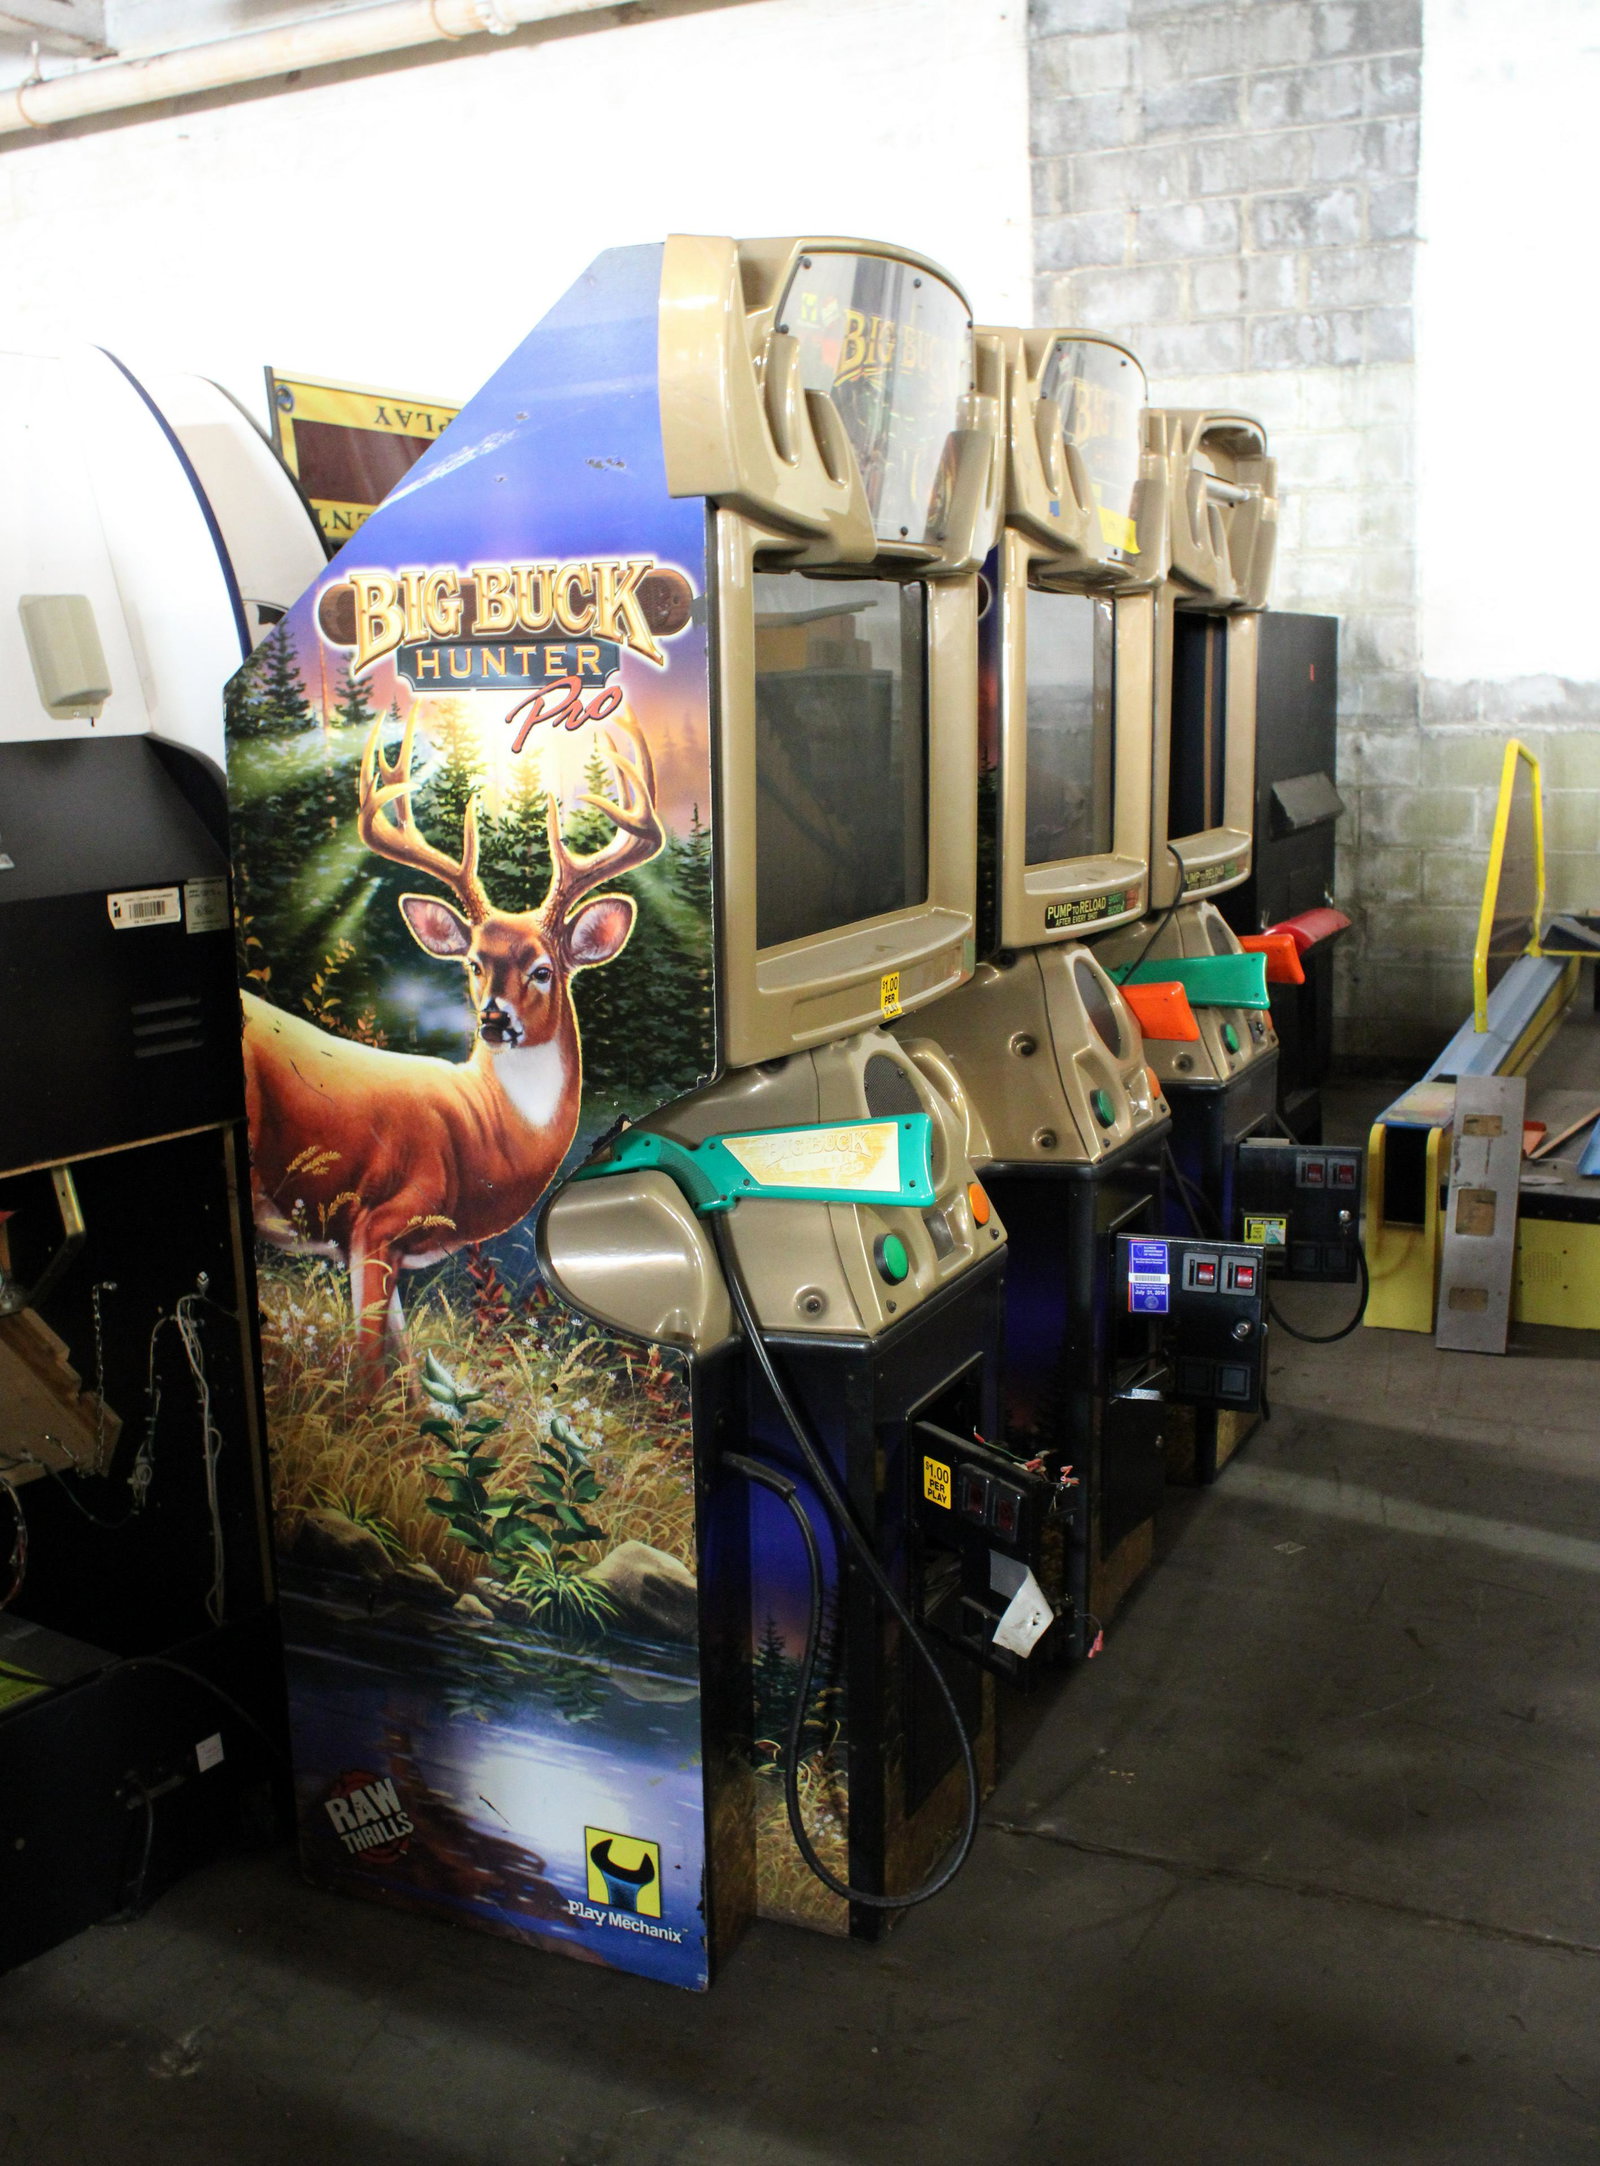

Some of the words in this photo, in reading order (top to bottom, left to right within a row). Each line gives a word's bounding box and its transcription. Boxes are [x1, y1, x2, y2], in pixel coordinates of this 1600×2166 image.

[835, 308, 897, 378] BIG
[350, 569, 464, 675] BIG
[472, 560, 664, 666] BUCK
[416, 643, 602, 679] HUNTER
[505, 676, 623, 754] Pro
[1047, 903, 1072, 920] PUMP
[1079, 896, 1107, 913] RELOAD
[1055, 916, 1071, 927] AFTER
[1072, 914, 1087, 923] EVERY
[1087, 911, 1098, 921] SHOT
[882, 976, 898, 993] $1.00
[884, 993, 895, 1005] PER
[925, 1461, 949, 1484] $1.00
[930, 1478, 945, 1493] PER
[927, 1487, 947, 1503] PLAY
[324, 1777, 401, 1834] RAW
[340, 1811, 415, 1855] THRILLS
[568, 1899, 607, 1926] Play
[608, 1911, 682, 1944] Mechanix
